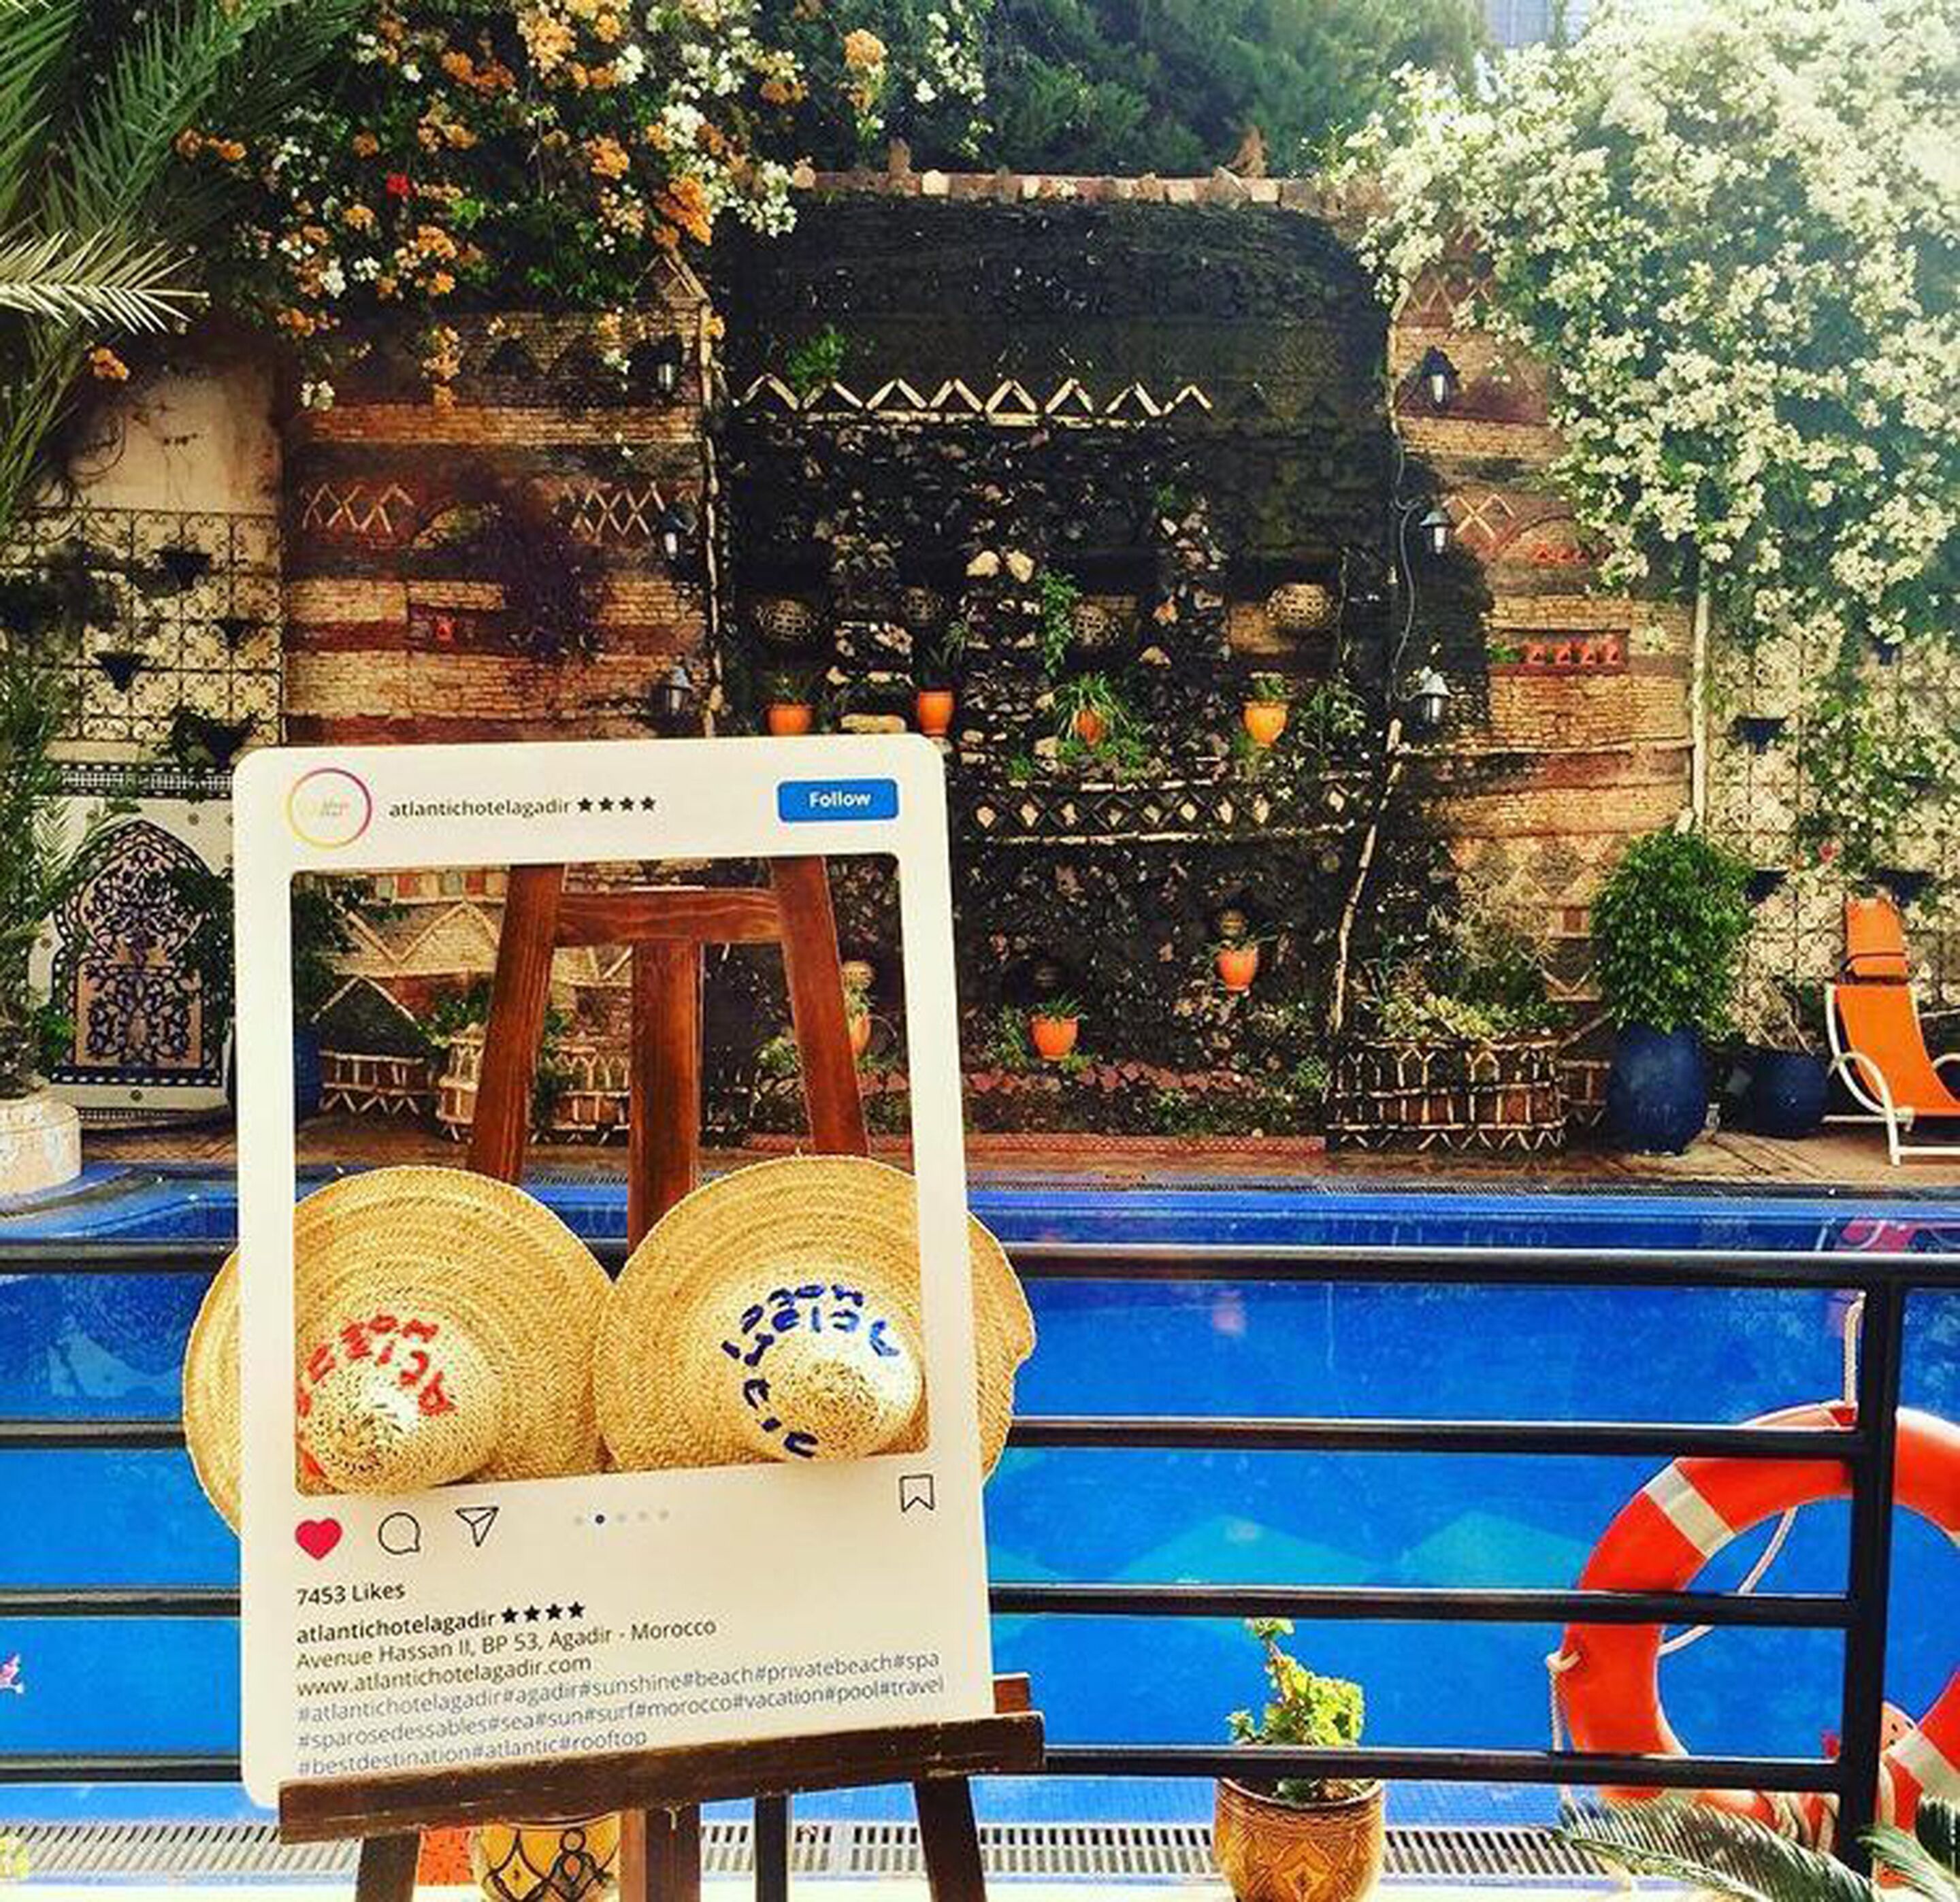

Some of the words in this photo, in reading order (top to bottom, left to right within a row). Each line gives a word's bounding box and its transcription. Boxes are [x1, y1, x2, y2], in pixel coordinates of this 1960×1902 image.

[389, 799, 570, 819] atlantichotelagadir
[808, 790, 871, 808] Follow
[297, 1586, 346, 1605] 7453
[352, 1581, 406, 1602] Likes
[297, 1610, 495, 1644] atlantichotelagadir
[296, 1647, 372, 1670] Avenue
[379, 1639, 453, 1662] Hassan
[483, 1635, 508, 1654] BP
[514, 1632, 544, 1654] 53,
[549, 1625, 612, 1652] Agadir
[631, 1618, 717, 1641] Morocco
[296, 1656, 592, 1696] www.atlantichotelagadir.com
